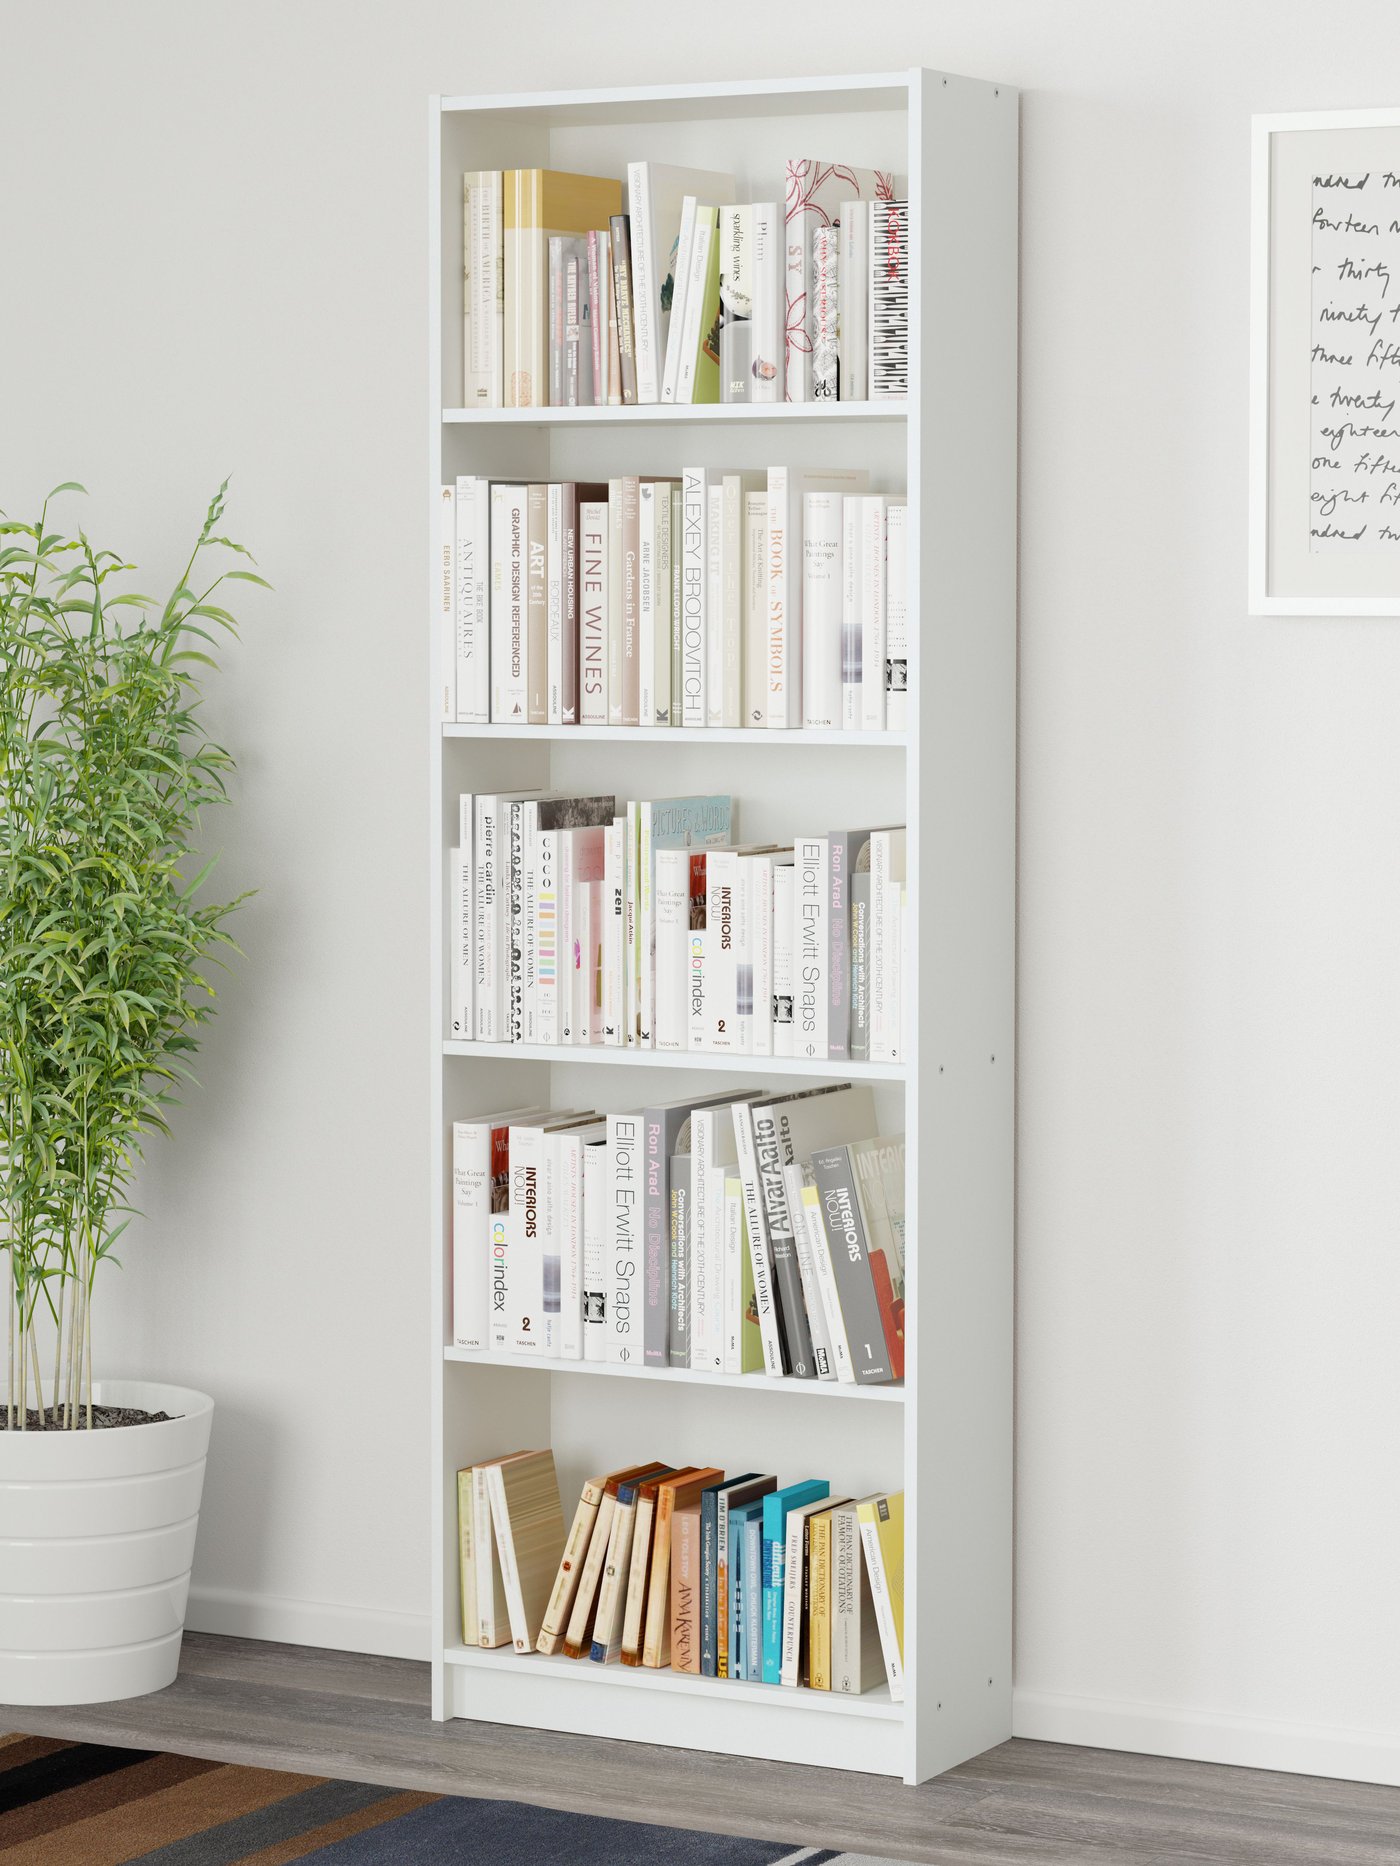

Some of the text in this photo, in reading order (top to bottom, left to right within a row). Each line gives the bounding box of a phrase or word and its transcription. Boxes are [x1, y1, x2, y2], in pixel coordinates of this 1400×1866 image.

[482, 204, 490, 304] BIRTH AMERICA
[694, 230, 706, 282] Italian Design
[732, 214, 743, 281] sparkling wines
[567, 262, 576, 324] THE KHYBER RIFLES
[1338, 258, 1390, 299] thirty
[1320, 301, 1382, 336] ninety
[1330, 386, 1395, 422] twenty
[1312, 457, 1342, 470] one
[711, 497, 720, 556] MAKING
[1310, 490, 1370, 516] eight
[530, 541, 544, 578] ART
[711, 562, 720, 576] IT
[770, 529, 782, 580] BOOK
[461, 539, 473, 659] ANTIQUAIRES
[511, 508, 520, 677] GRAPHIC DESIGN REFERENCED
[550, 581, 559, 642] BORDEAUX
[585, 533, 602, 695] FINE WINES
[625, 551, 635, 658] Gardens in France
[685, 474, 702, 710] ALEXEY BRODOVITCH
[770, 601, 782, 692] SYMBOLS
[485, 816, 494, 905] pierre cardin
[832, 844, 842, 872] Ron
[711, 886, 721, 921] NOW!
[721, 887, 731, 950] INTERIORS
[832, 877, 842, 909] Arad
[463, 928, 468, 942] OF
[478, 929, 485, 944] OF
[527, 933, 534, 948] OF
[799, 844, 820, 1032] Elliott Erwitt Snaps
[832, 918, 842, 937] No
[691, 938, 705, 1016] colorindex
[858, 902, 866, 1028] Conversations with Architects
[717, 1019, 726, 1033] 2
[514, 1166, 525, 1205] NOW!
[755, 1118, 790, 1232] Alvar Aalto
[526, 1166, 536, 1238] INTERIORS
[612, 1121, 635, 1334] Elliott Erwitt Snaps
[646, 1124, 661, 1306] Ron Arad No Discipline
[696, 1119, 704, 1316] VISIONARY ARCHITECTURE OF THE 20TH CENTURY
[824, 1190, 843, 1232] NOW!
[836, 1187, 861, 1262] INTERIORS
[728, 1227, 736, 1253] Design
[745, 1180, 770, 1315] THE ALLURE OF WOMEN
[810, 1211, 828, 1276] American Design
[493, 1223, 508, 1311] colorindex
[522, 1317, 531, 1331] 2
[767, 1340, 775, 1370] ASSOULINE
[817, 1349, 827, 1374] MoMA
[864, 1344, 872, 1359] 1
[681, 1516, 689, 1579] LEO TOLSTOY
[749, 1529, 757, 1572] DOWNTOWN
[772, 1541, 785, 1588] difficult
[865, 1528, 883, 1594] American Design
[678, 1581, 692, 1616] ANNA
[750, 1573, 758, 1589] OWL
[750, 1592, 758, 1617] CHUCK
[786, 1601, 795, 1662] COUNTERPUNCH
[818, 1607, 825, 1617] OF
[846, 1604, 853, 1615] OF
